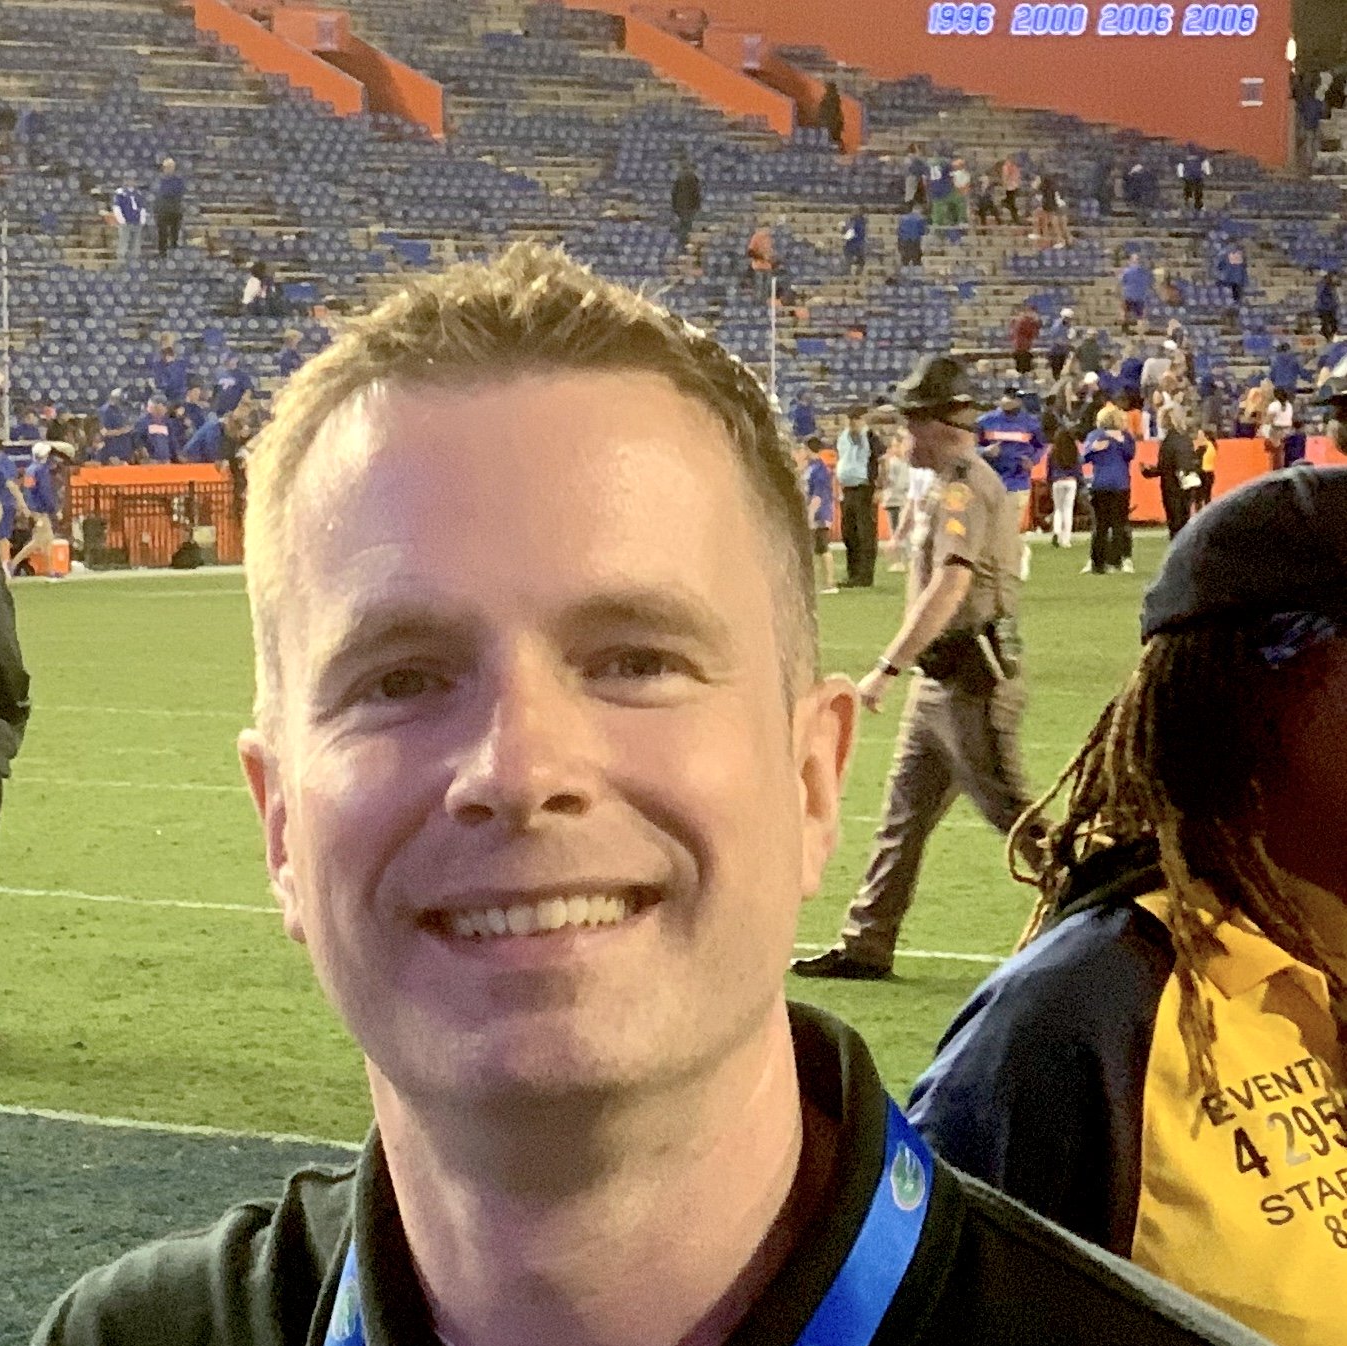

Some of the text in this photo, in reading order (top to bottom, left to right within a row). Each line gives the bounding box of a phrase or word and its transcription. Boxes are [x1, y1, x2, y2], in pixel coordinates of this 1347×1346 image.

[927, 2, 1259, 36] 1996 2000 2006 2008
[1201, 1058, 1321, 1126] EVENT
[1233, 1126, 1272, 1178] 4
